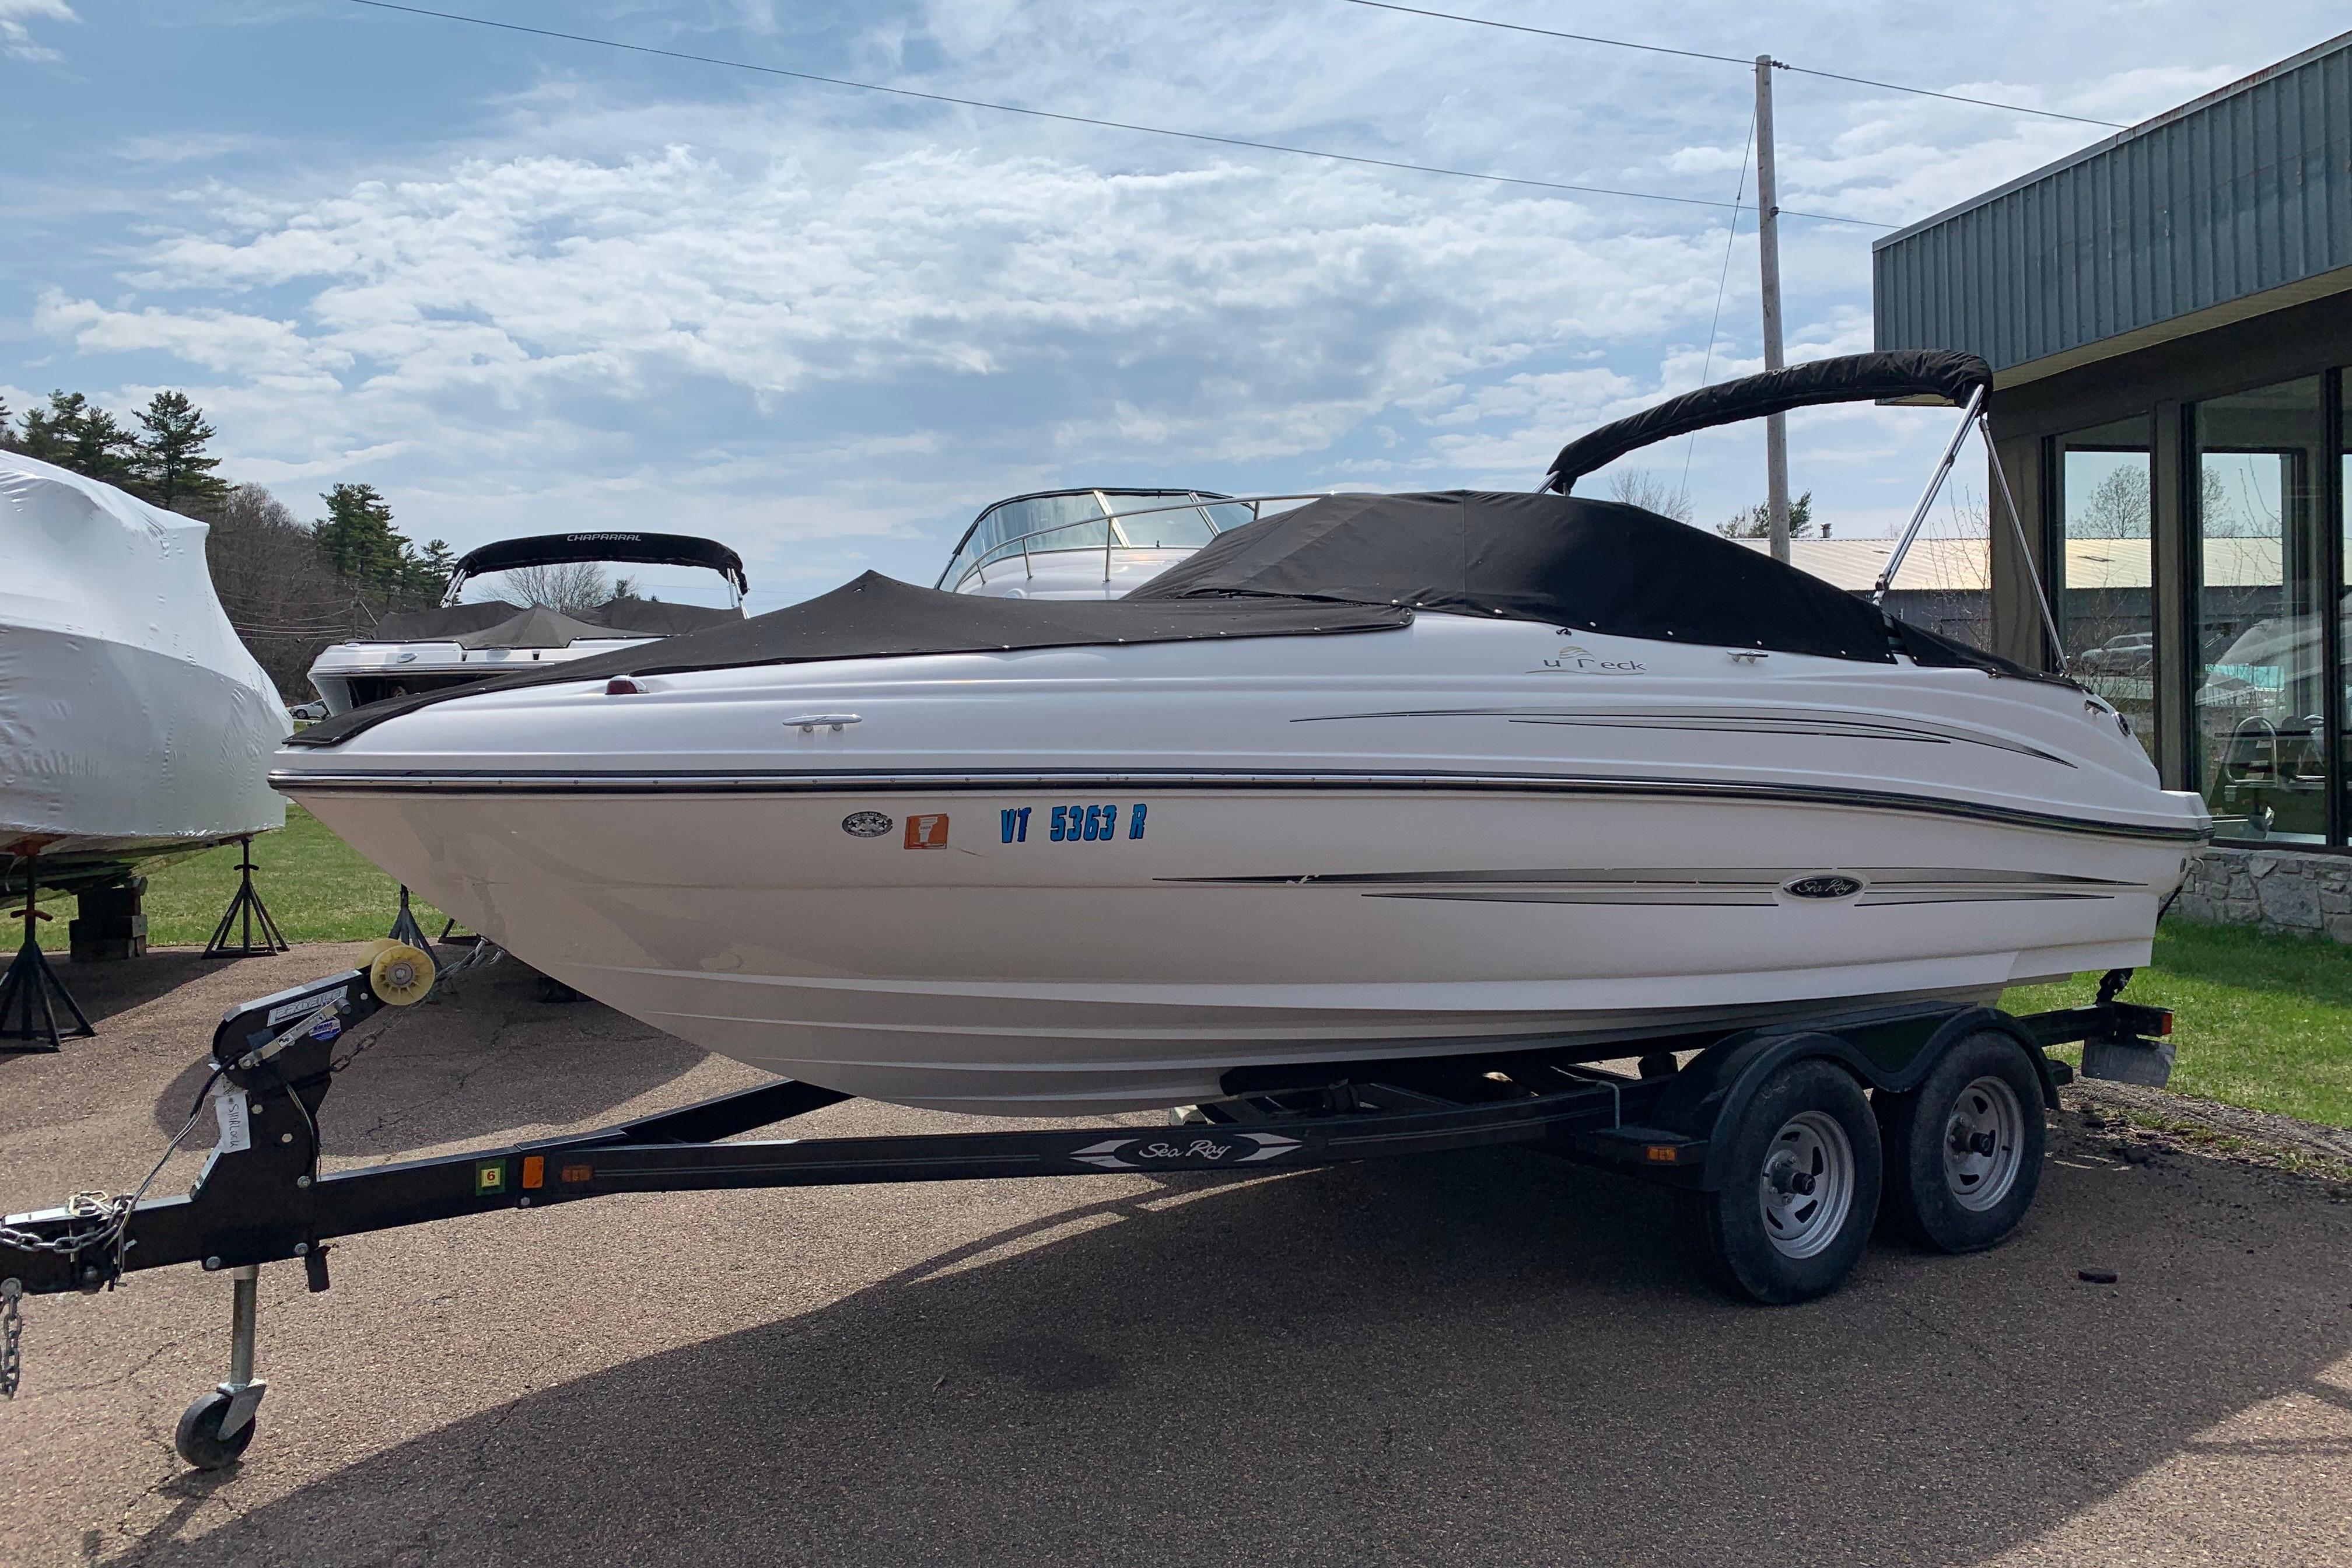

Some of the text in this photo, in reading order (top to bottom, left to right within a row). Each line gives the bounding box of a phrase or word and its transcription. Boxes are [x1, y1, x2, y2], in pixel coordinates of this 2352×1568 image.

[566, 533, 642, 541] CHAPARRAL
[1001, 803, 1147, 844] VT 5363 R
[1797, 878, 1853, 895] Sea Ray
[275, 989, 342, 1017] PROFILE
[1139, 1140, 1232, 1160] Sea Ray
[487, 1170, 496, 1181] 6
